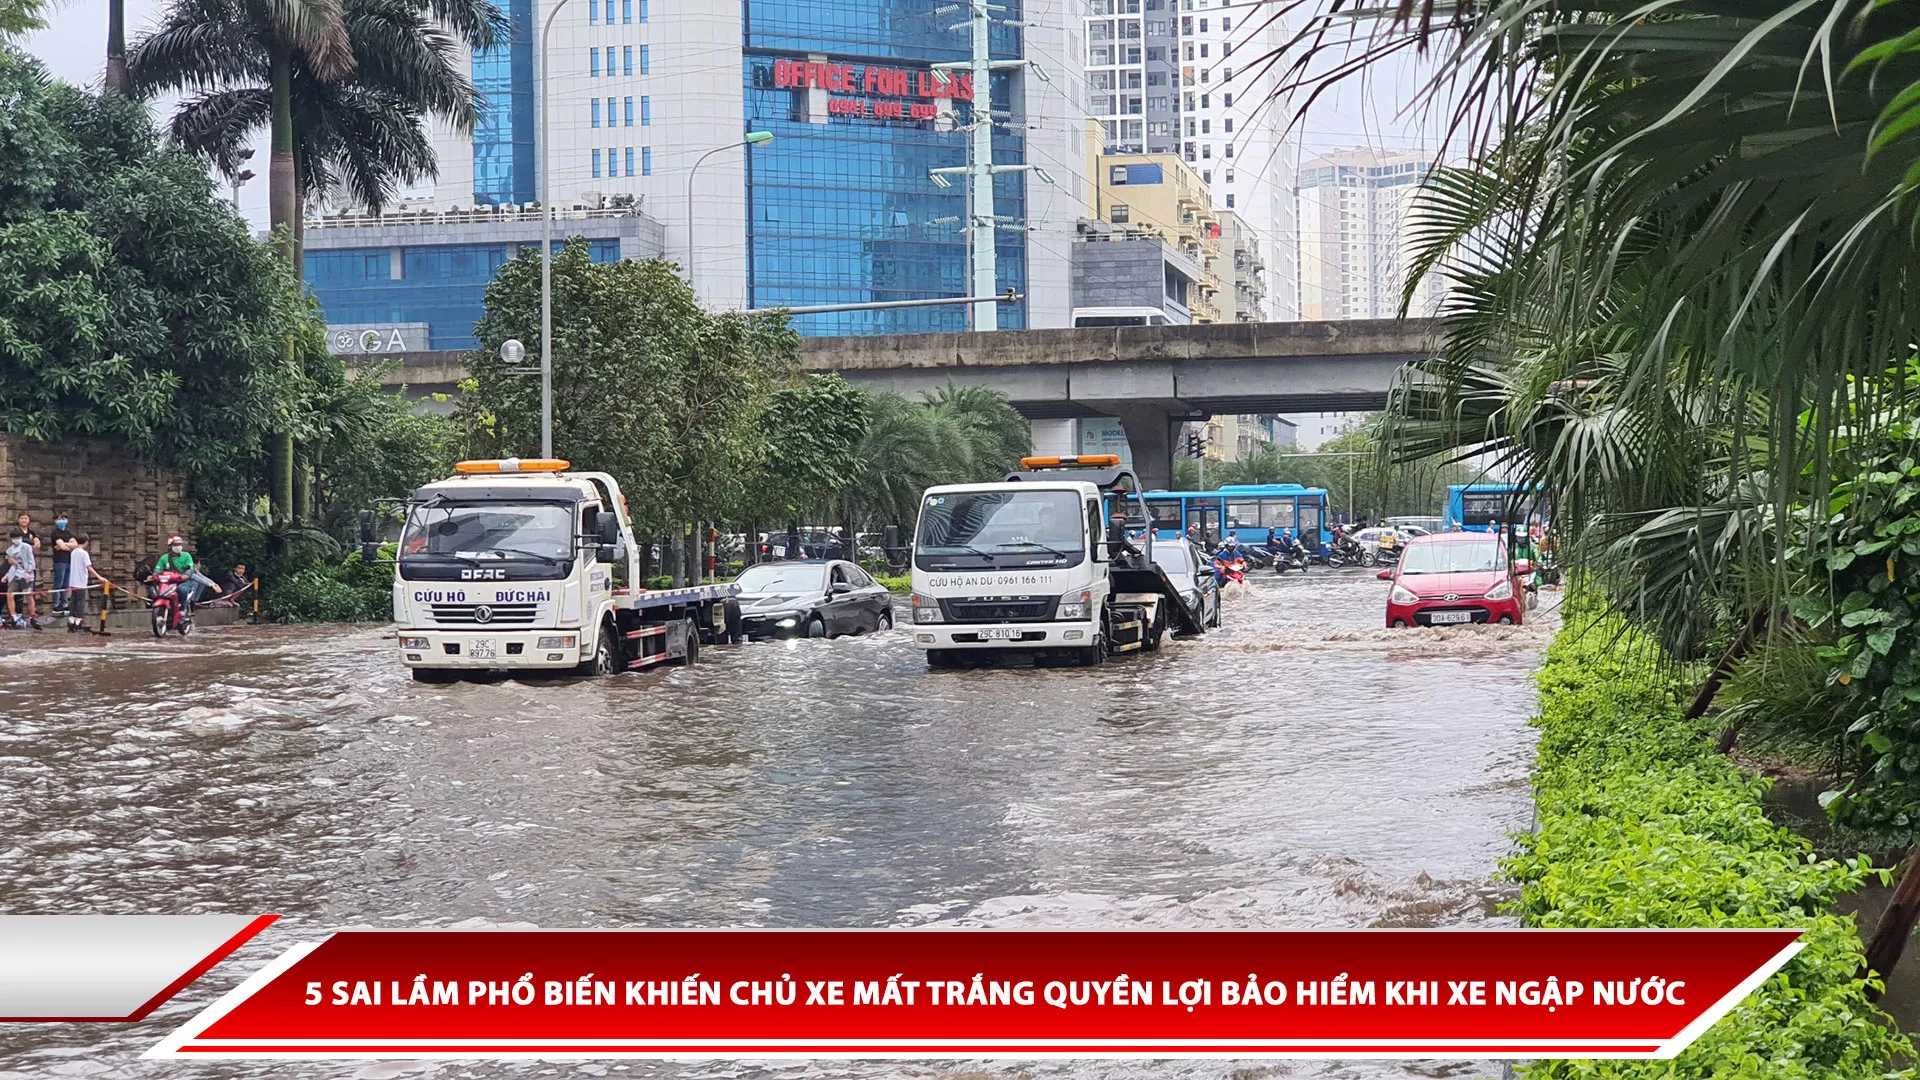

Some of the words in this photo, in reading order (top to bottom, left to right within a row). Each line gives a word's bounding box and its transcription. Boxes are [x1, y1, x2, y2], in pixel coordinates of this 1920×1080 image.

[774, 60, 855, 92] OFFICE
[864, 66, 908, 96] FOR
[461, 569, 506, 579] DFAC
[929, 576, 948, 587] CỨU
[950, 576, 964, 588] HỘ
[966, 576, 978, 586] AN
[998, 576, 1018, 585] 0961
[1022, 576, 1036, 584] 166
[1040, 575, 1052, 583] 111
[414, 588, 442, 602] CỨU
[495, 588, 526, 602] ĐỨC
[475, 639, 490, 649] 29C
